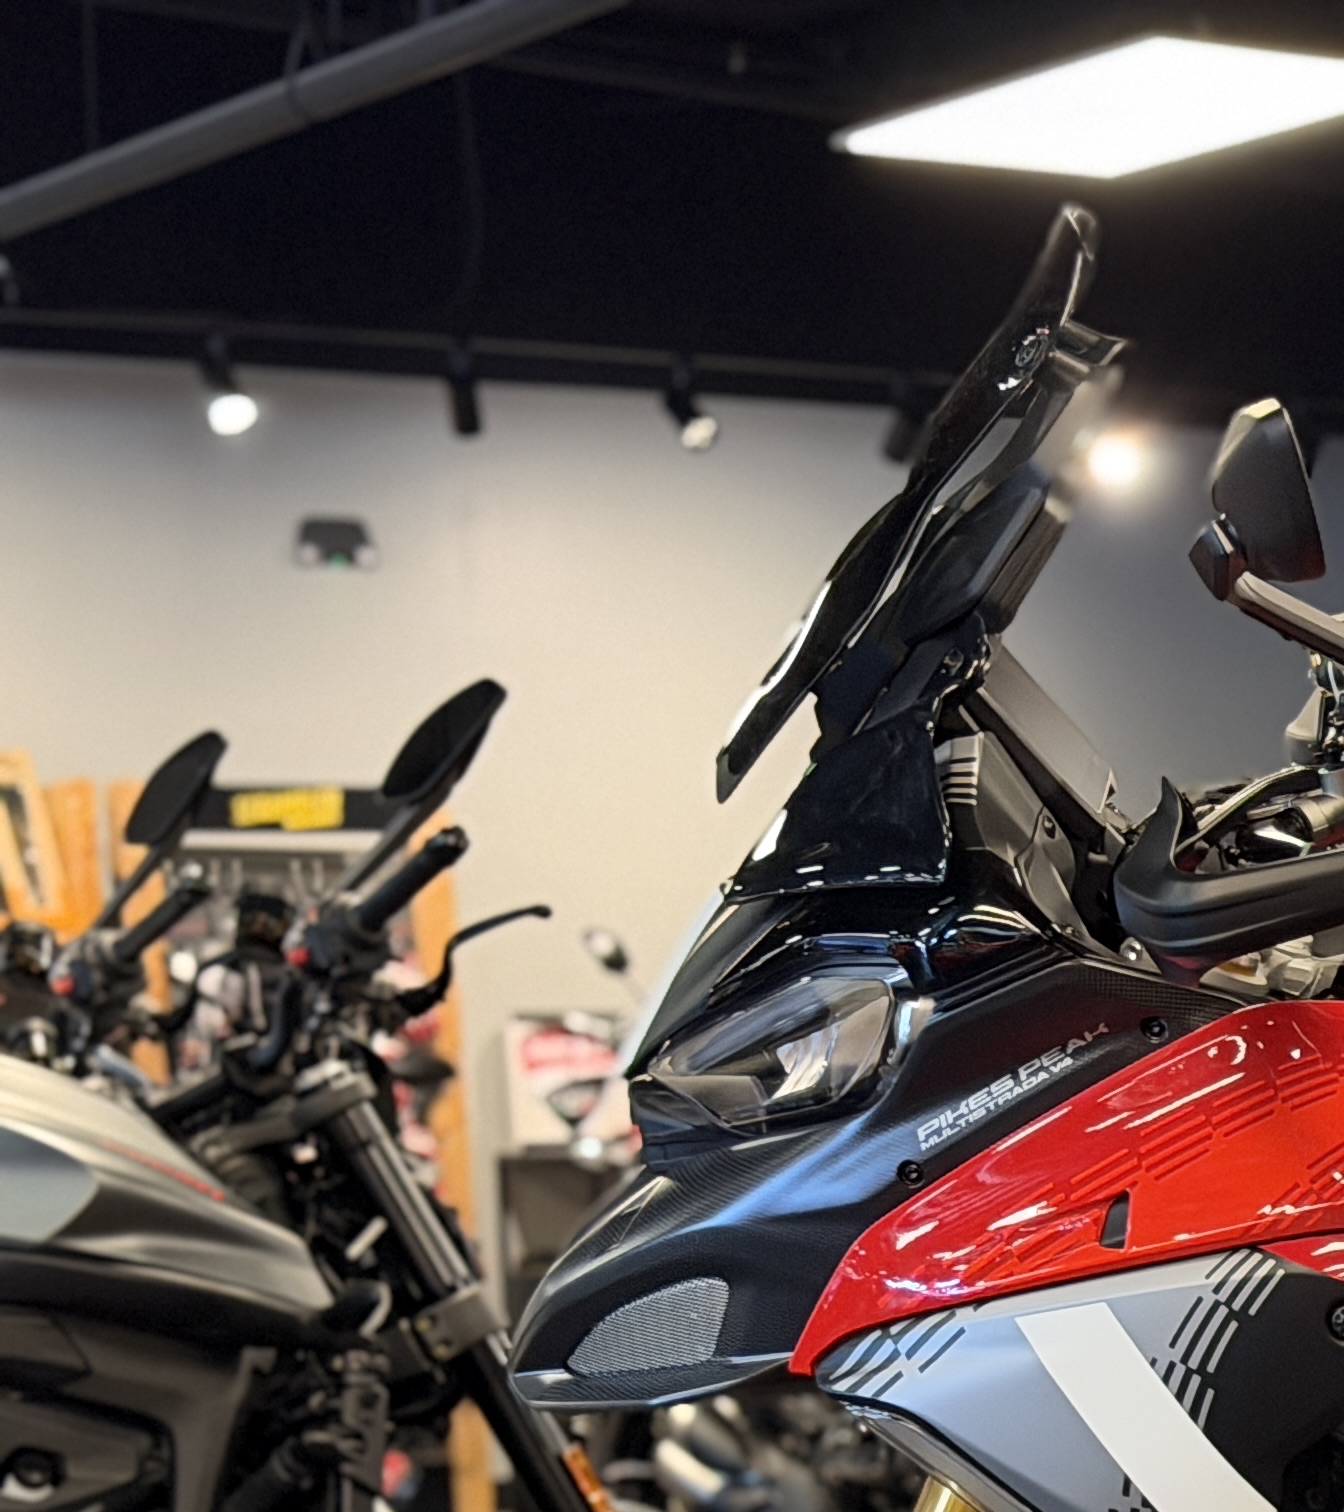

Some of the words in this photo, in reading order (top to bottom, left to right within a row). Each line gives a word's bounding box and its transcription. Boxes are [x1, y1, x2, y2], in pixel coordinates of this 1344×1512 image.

[917, 1074, 1014, 1141] PIKES
[1018, 1023, 1109, 1081] PEAK
[920, 1072, 1050, 1151] MULTISTRADA
[1050, 1057, 1073, 1073] V4
